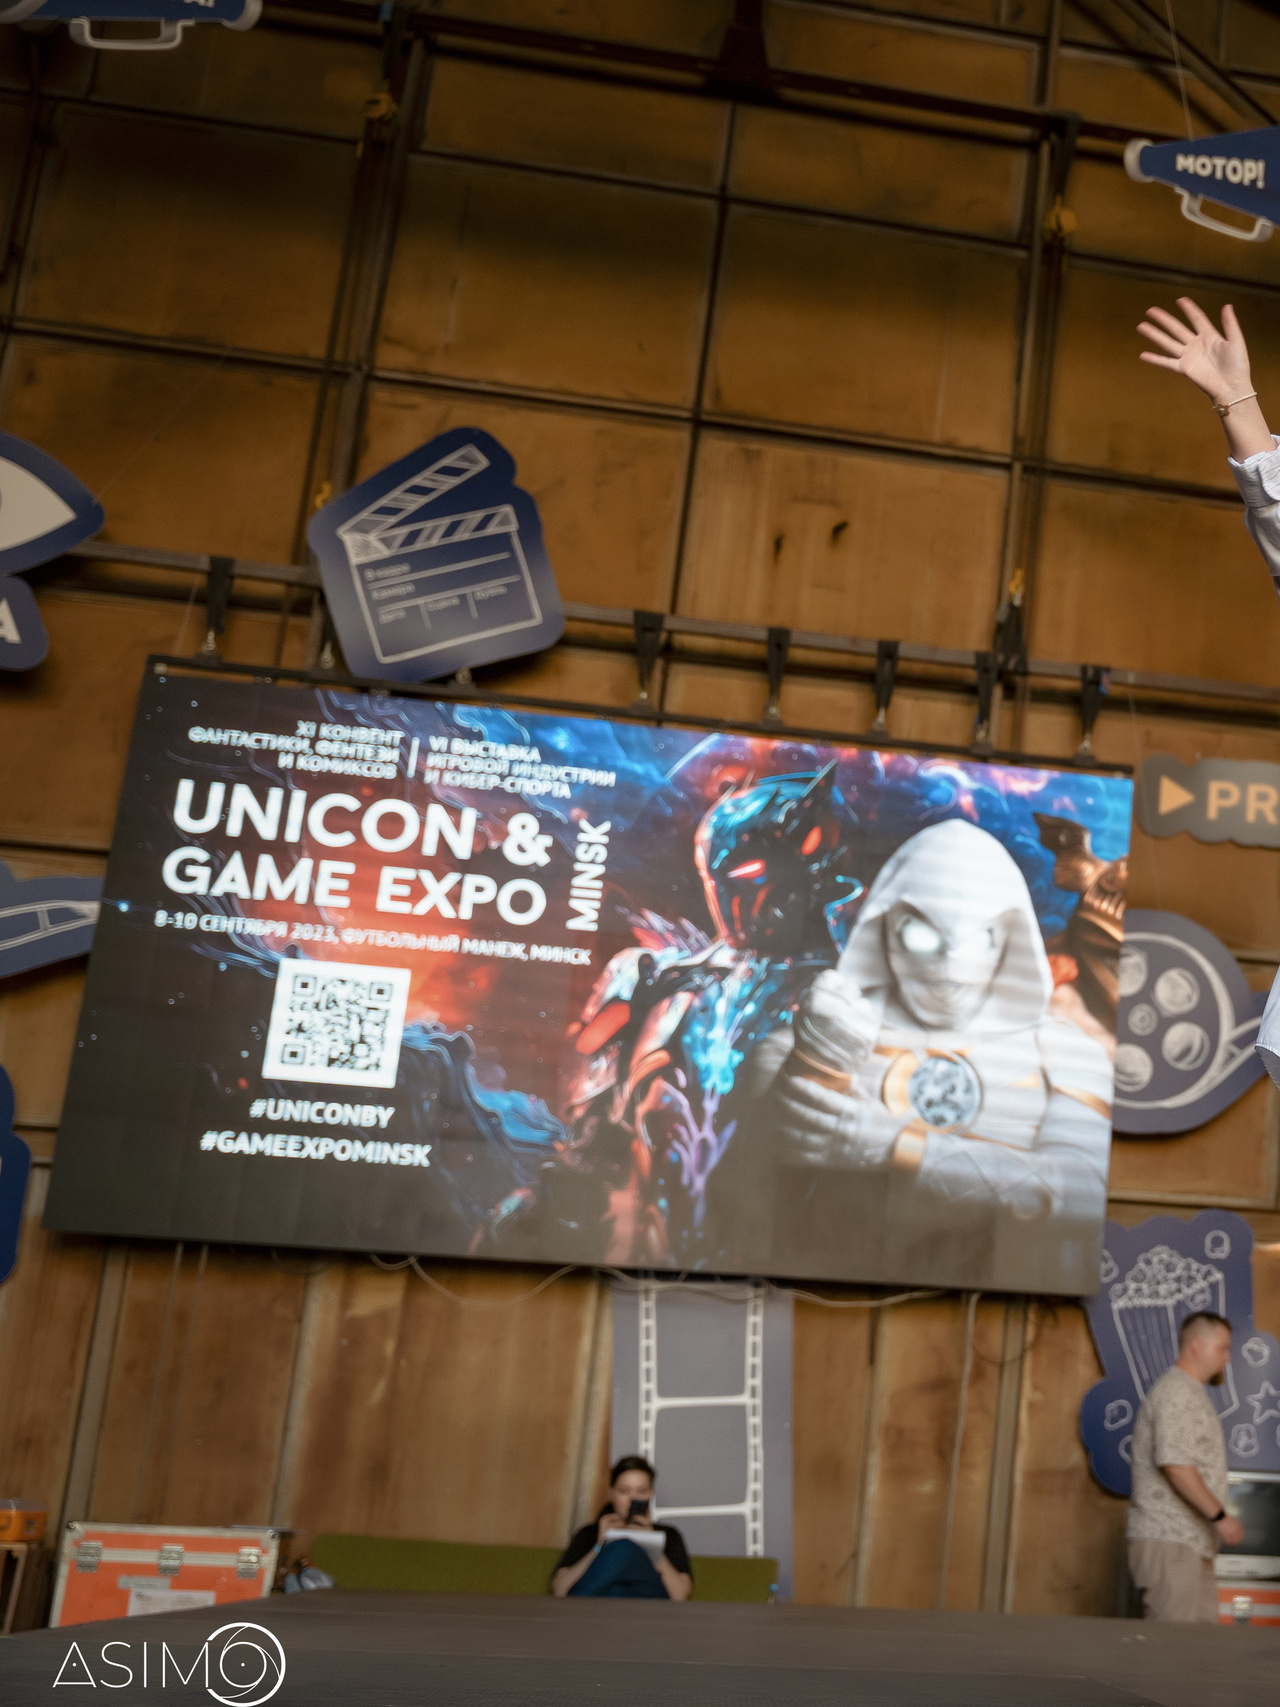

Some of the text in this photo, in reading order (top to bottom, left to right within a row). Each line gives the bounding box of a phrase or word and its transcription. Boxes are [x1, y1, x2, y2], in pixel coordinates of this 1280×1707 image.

[1175, 153, 1266, 190] МОТОР!
[188, 725, 399, 764] ФАНТАСТИКИ, ФЕНТЕЗИ
[319, 722, 405, 747] КОНВЕНТ
[450, 737, 541, 763] ВЫСТАВКА
[278, 752, 398, 779] И КОМИКСОВ
[424, 769, 571, 799] И КИБЕР-СПОРТА
[426, 751, 616, 788] ИГРОВОЙ ИНДУСТРИИ
[173, 778, 554, 867] UNICON &
[162, 846, 547, 926] GAME EXPO
[565, 819, 612, 932] MINSK
[154, 909, 592, 965] 8-10 СЕНТЯБРЯ 2023, ФУТБОЛЬНЫЙ МАНЕЖ, МИНСК
[250, 1098, 396, 1128] #UNICONBY
[200, 1130, 432, 1168] #GAMEEXPOMINSK
